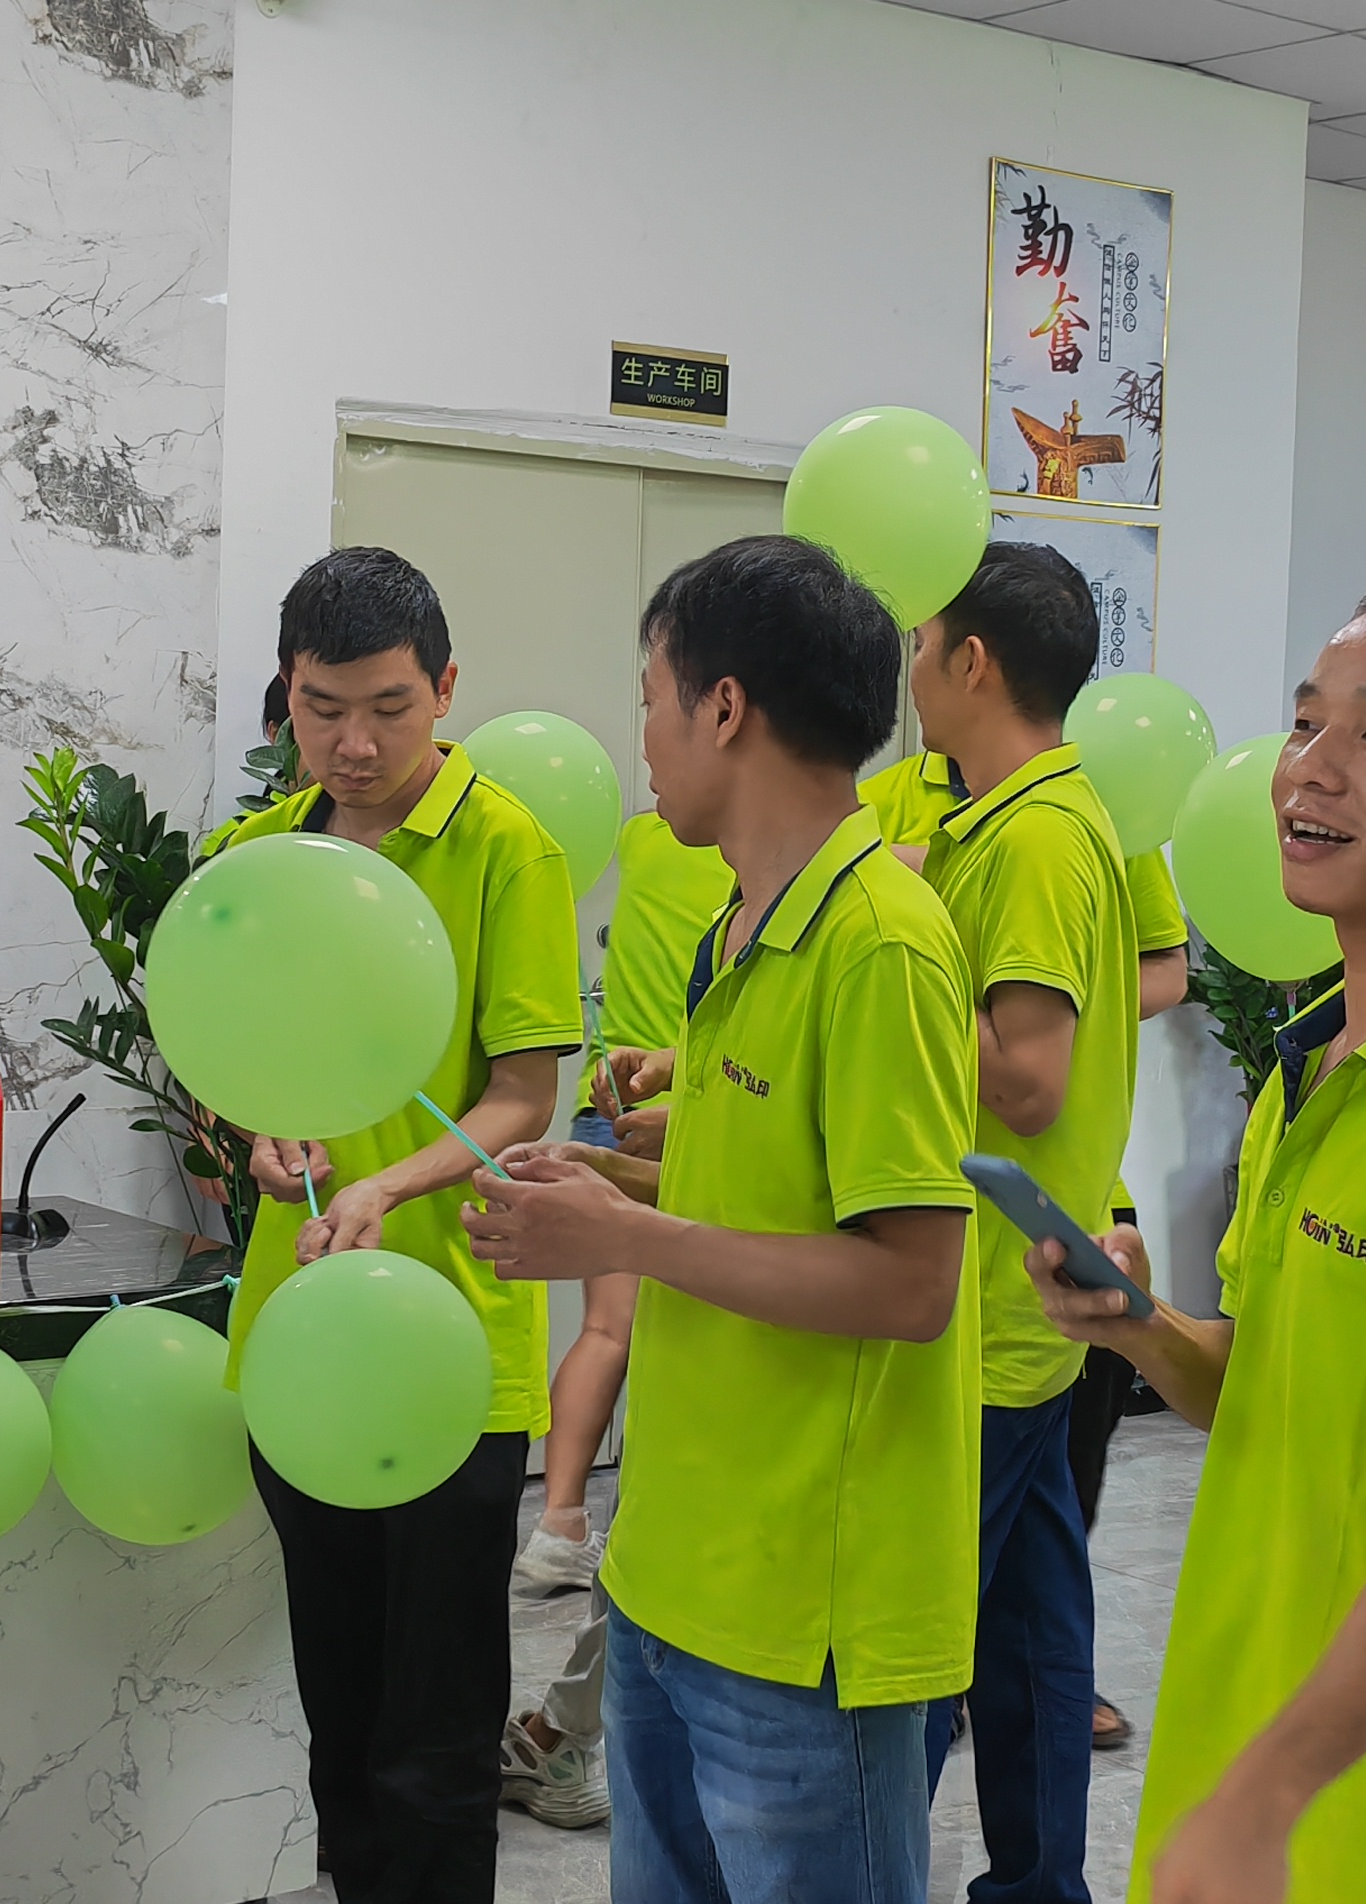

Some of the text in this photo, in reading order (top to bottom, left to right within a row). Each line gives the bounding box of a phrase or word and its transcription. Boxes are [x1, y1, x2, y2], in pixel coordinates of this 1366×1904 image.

[1114, 291, 1122, 329] CULTURE
[621, 357, 722, 395] 生产车间
[647, 393, 695, 408] WORKSHOP
[1101, 627, 1109, 665] CULTURE
